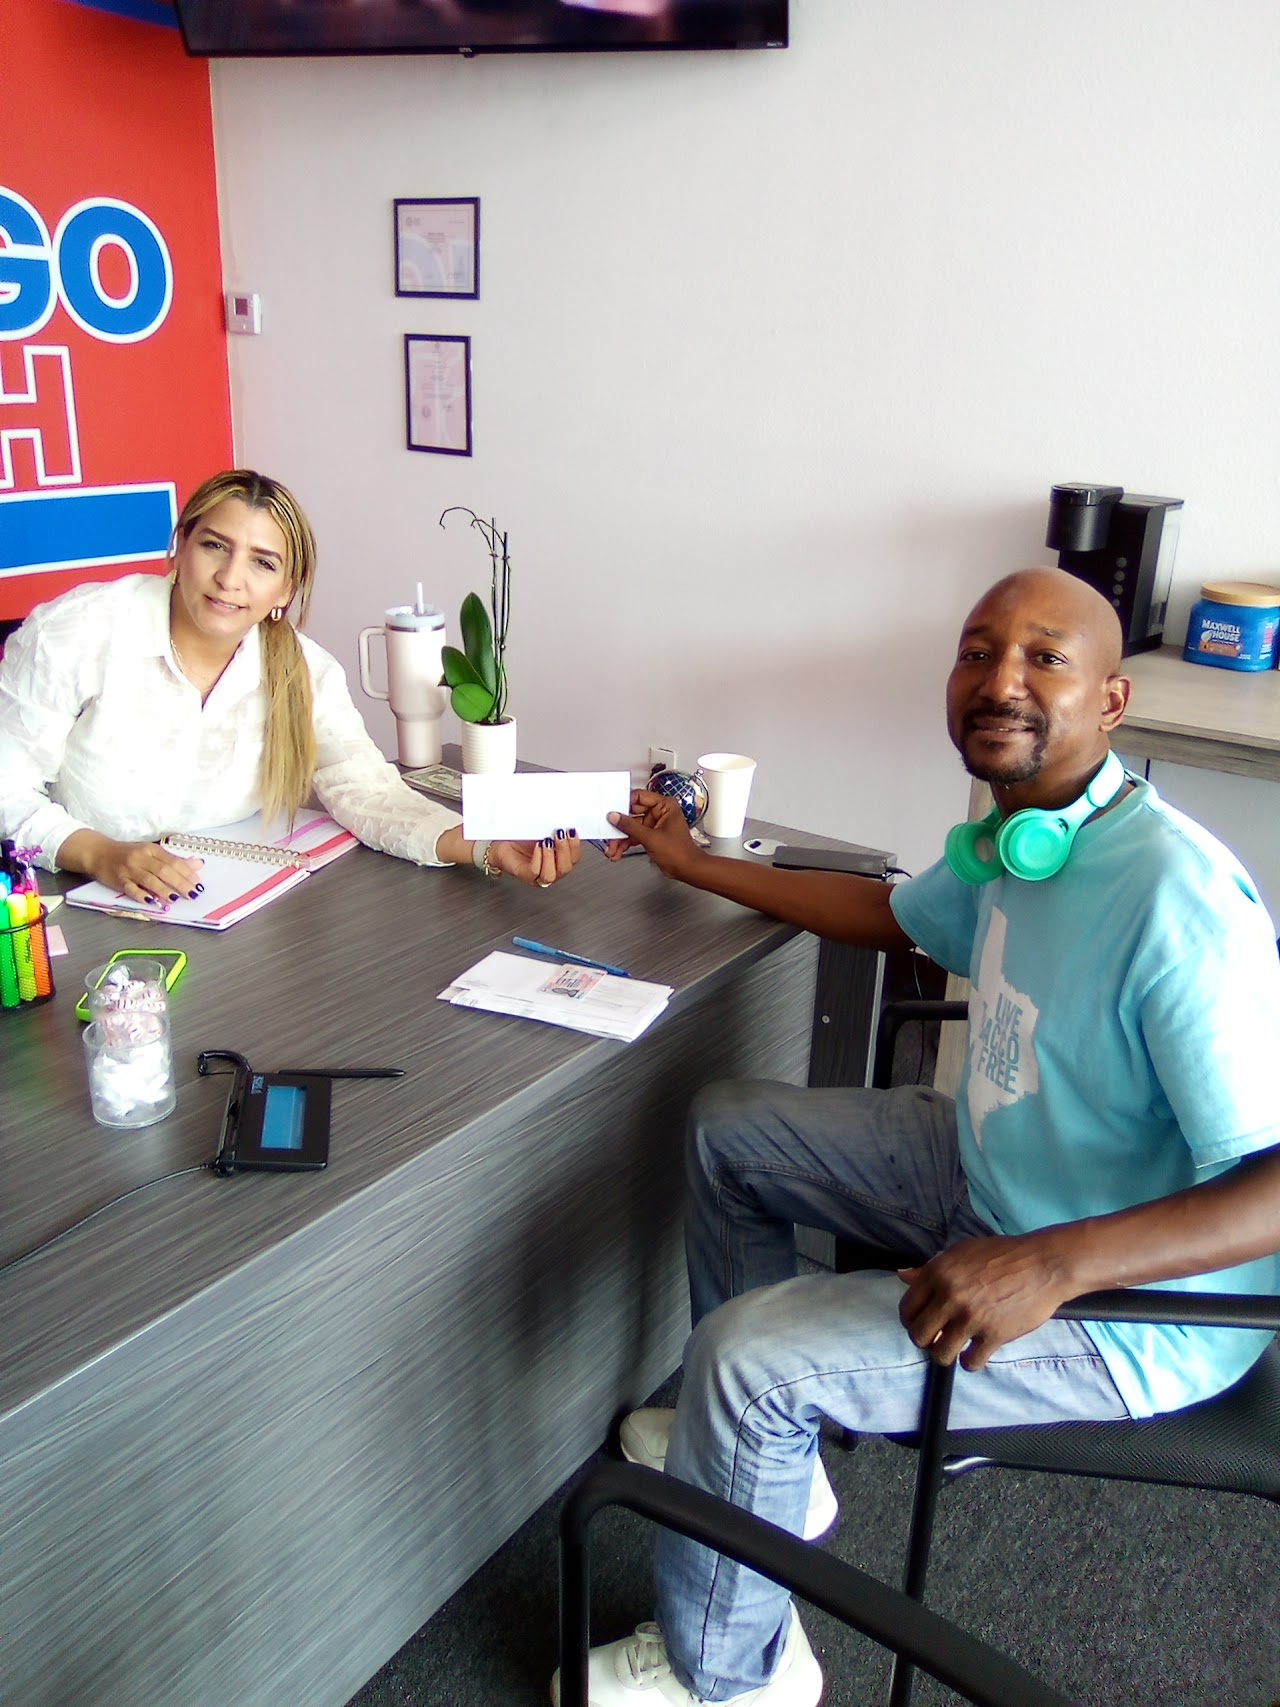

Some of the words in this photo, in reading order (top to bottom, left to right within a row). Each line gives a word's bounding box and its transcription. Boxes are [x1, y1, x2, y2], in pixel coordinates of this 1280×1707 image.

[1202, 619, 1240, 633] MAXWELL
[1212, 630, 1240, 642] HOUSE
[995, 992, 1023, 1038] LIVE
[977, 1045, 1019, 1094] FREE
